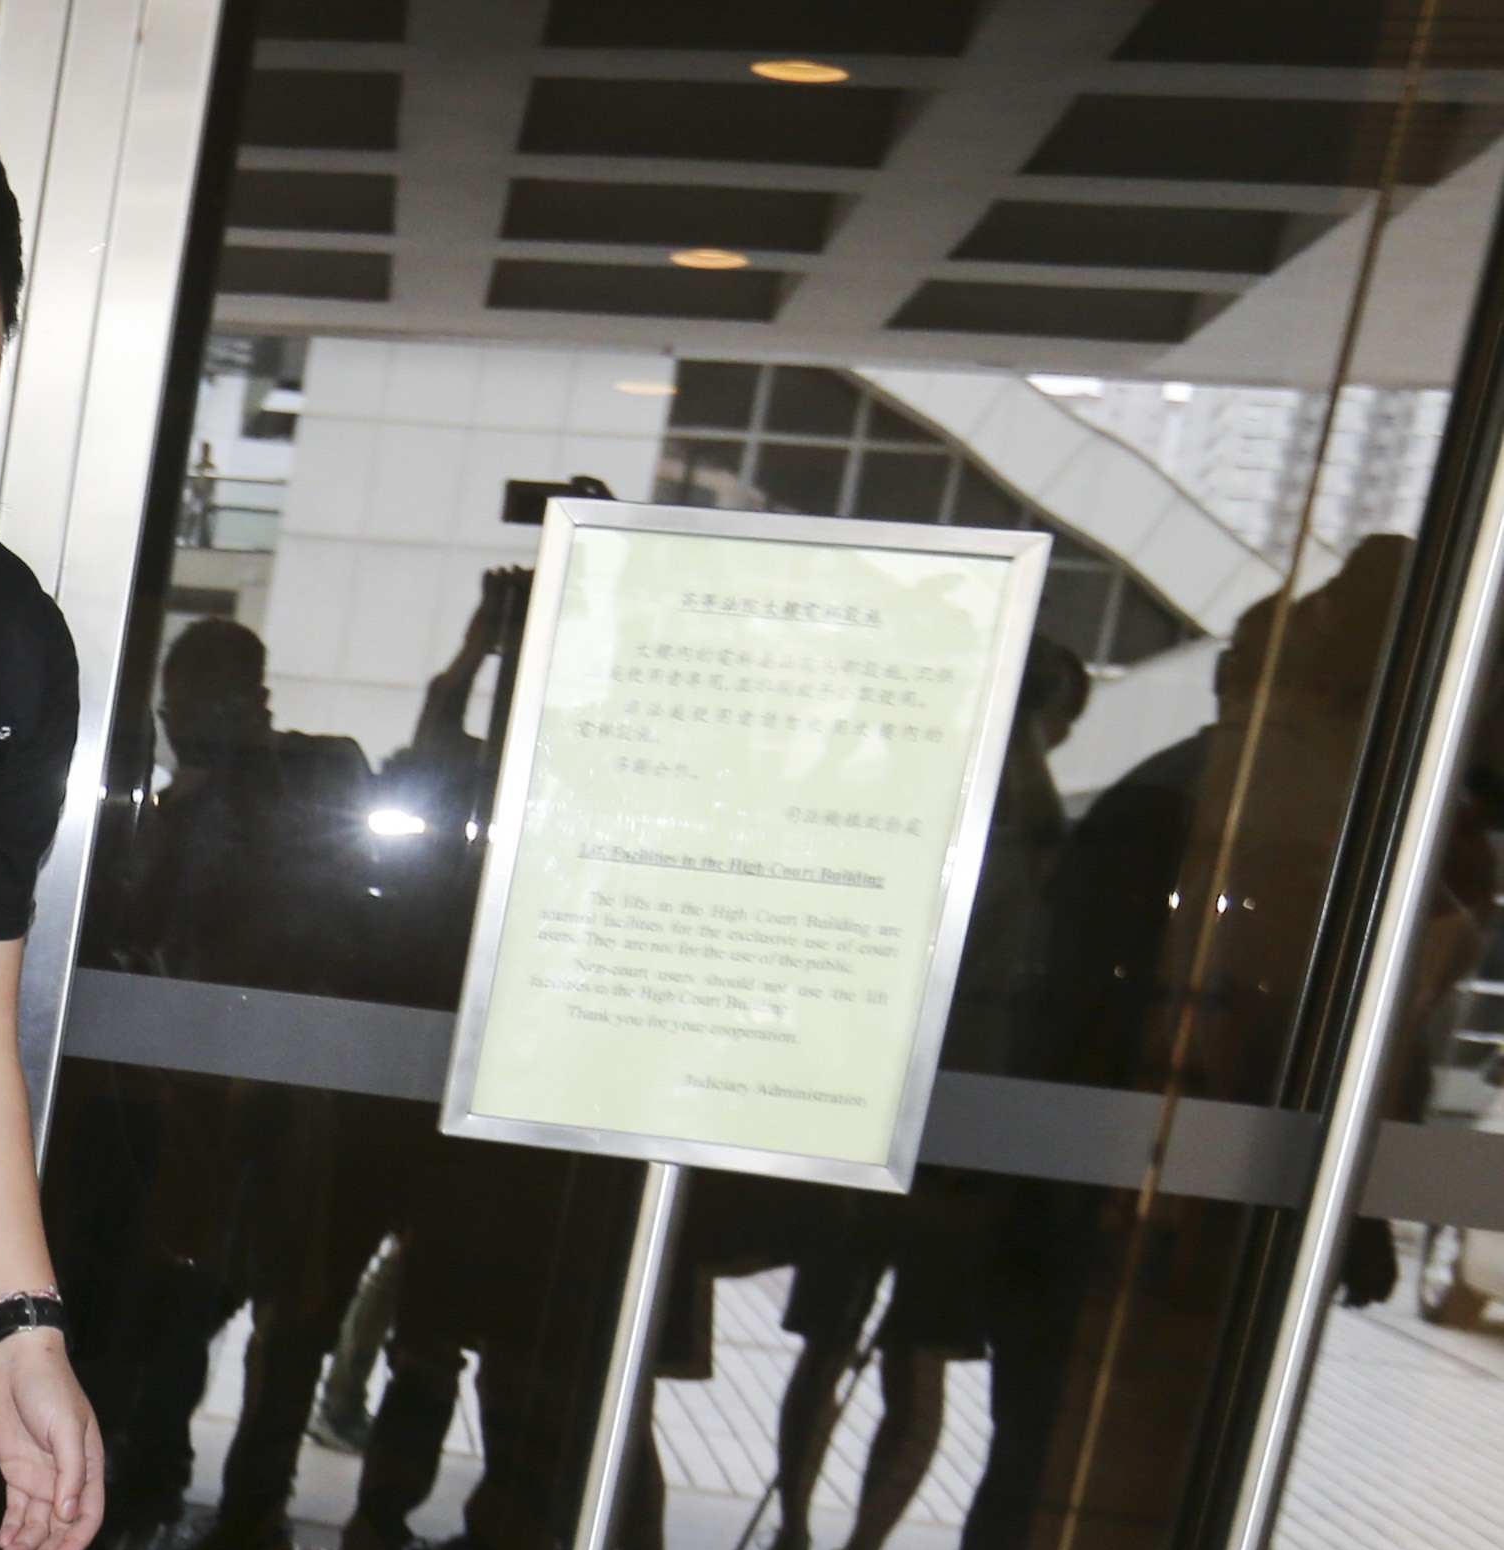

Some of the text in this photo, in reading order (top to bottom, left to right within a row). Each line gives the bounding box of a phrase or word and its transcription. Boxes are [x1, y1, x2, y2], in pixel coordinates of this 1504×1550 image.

[612, 846, 679, 865] Facilities
[682, 854, 695, 867] in
[701, 855, 725, 870] the
[729, 858, 766, 877] High
[771, 862, 814, 879] Court
[820, 867, 886, 889] Building
[588, 892, 903, 938] The lifts in the High Court Building are
[585, 933, 618, 952] They
[624, 941, 648, 952] are
[679, 943, 700, 957] for
[704, 946, 727, 960] the
[730, 953, 755, 963] use
[760, 952, 778, 965] of
[780, 954, 802, 968] the
[604, 915, 666, 933] facilities
[672, 922, 692, 936] for
[700, 925, 722, 939] the
[728, 927, 799, 947] exclusive
[805, 940, 829, 950] use
[837, 939, 854, 953] of
[859, 941, 899, 957] court
[613, 983, 636, 998] the
[639, 986, 675, 1006] High
[679, 991, 721, 1008] Court
[706, 974, 754, 990] should
[798, 987, 823, 998] use
[833, 988, 856, 1001] the
[866, 991, 889, 1005] lift
[568, 1005, 612, 1023] Thank
[616, 1015, 642, 1030] you
[647, 1014, 669, 1029] for
[670, 1021, 707, 1037] your
[685, 1075, 868, 1107] Judiciary Administration
